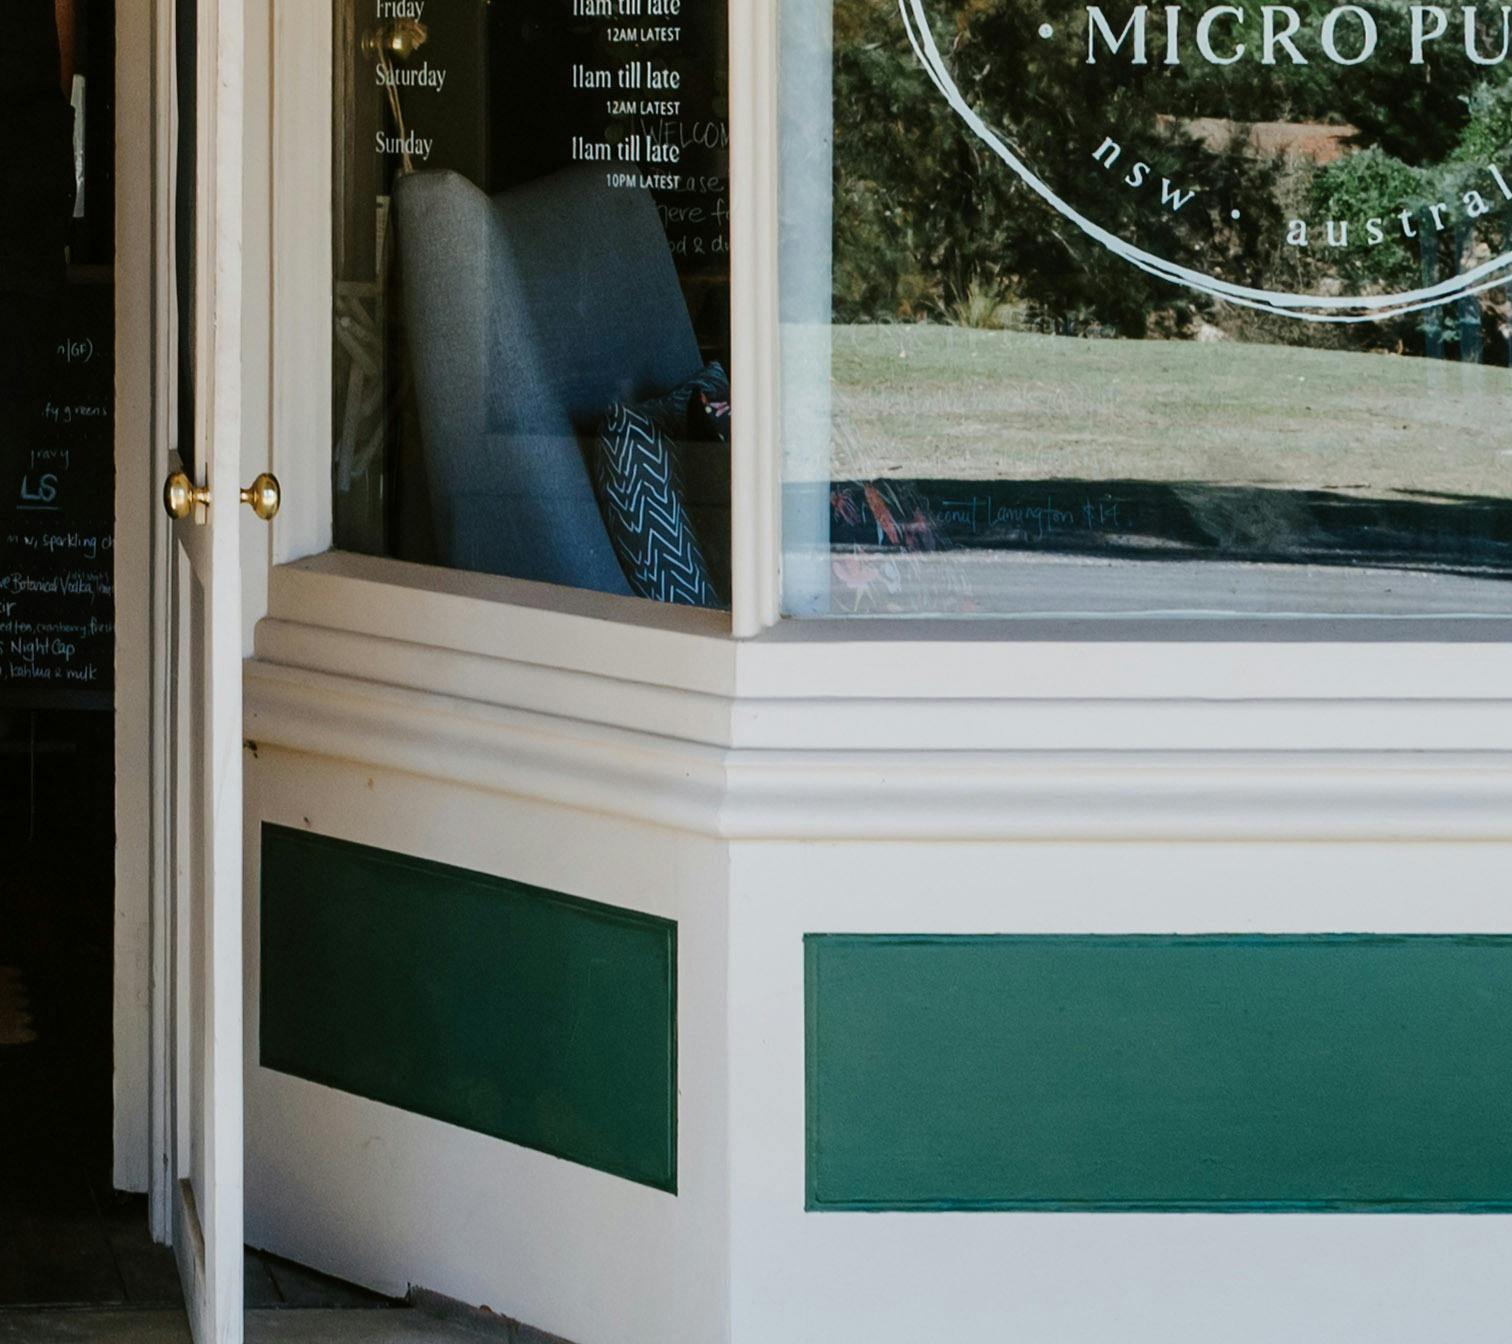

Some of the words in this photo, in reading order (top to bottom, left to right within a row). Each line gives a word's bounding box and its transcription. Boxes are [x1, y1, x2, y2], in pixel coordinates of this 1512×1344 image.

[606, 27, 638, 42] 12AM
[639, 27, 681, 42] LATEST
[1085, 4, 1379, 67] MICRO
[375, 61, 447, 92] Saturday
[572, 64, 612, 89] 11am
[618, 61, 641, 89] till
[646, 61, 681, 90] late
[606, 100, 637, 115] 12AM
[639, 100, 681, 116] LATEST
[375, 130, 433, 160] Sunday
[572, 135, 611, 161] 11am
[617, 134, 640, 162] till
[645, 134, 680, 164] late
[606, 174, 637, 188] 10PM
[639, 173, 681, 191] LATEST
[1091, 132, 1197, 214] nsw
[51, 638, 76, 662] Cap
